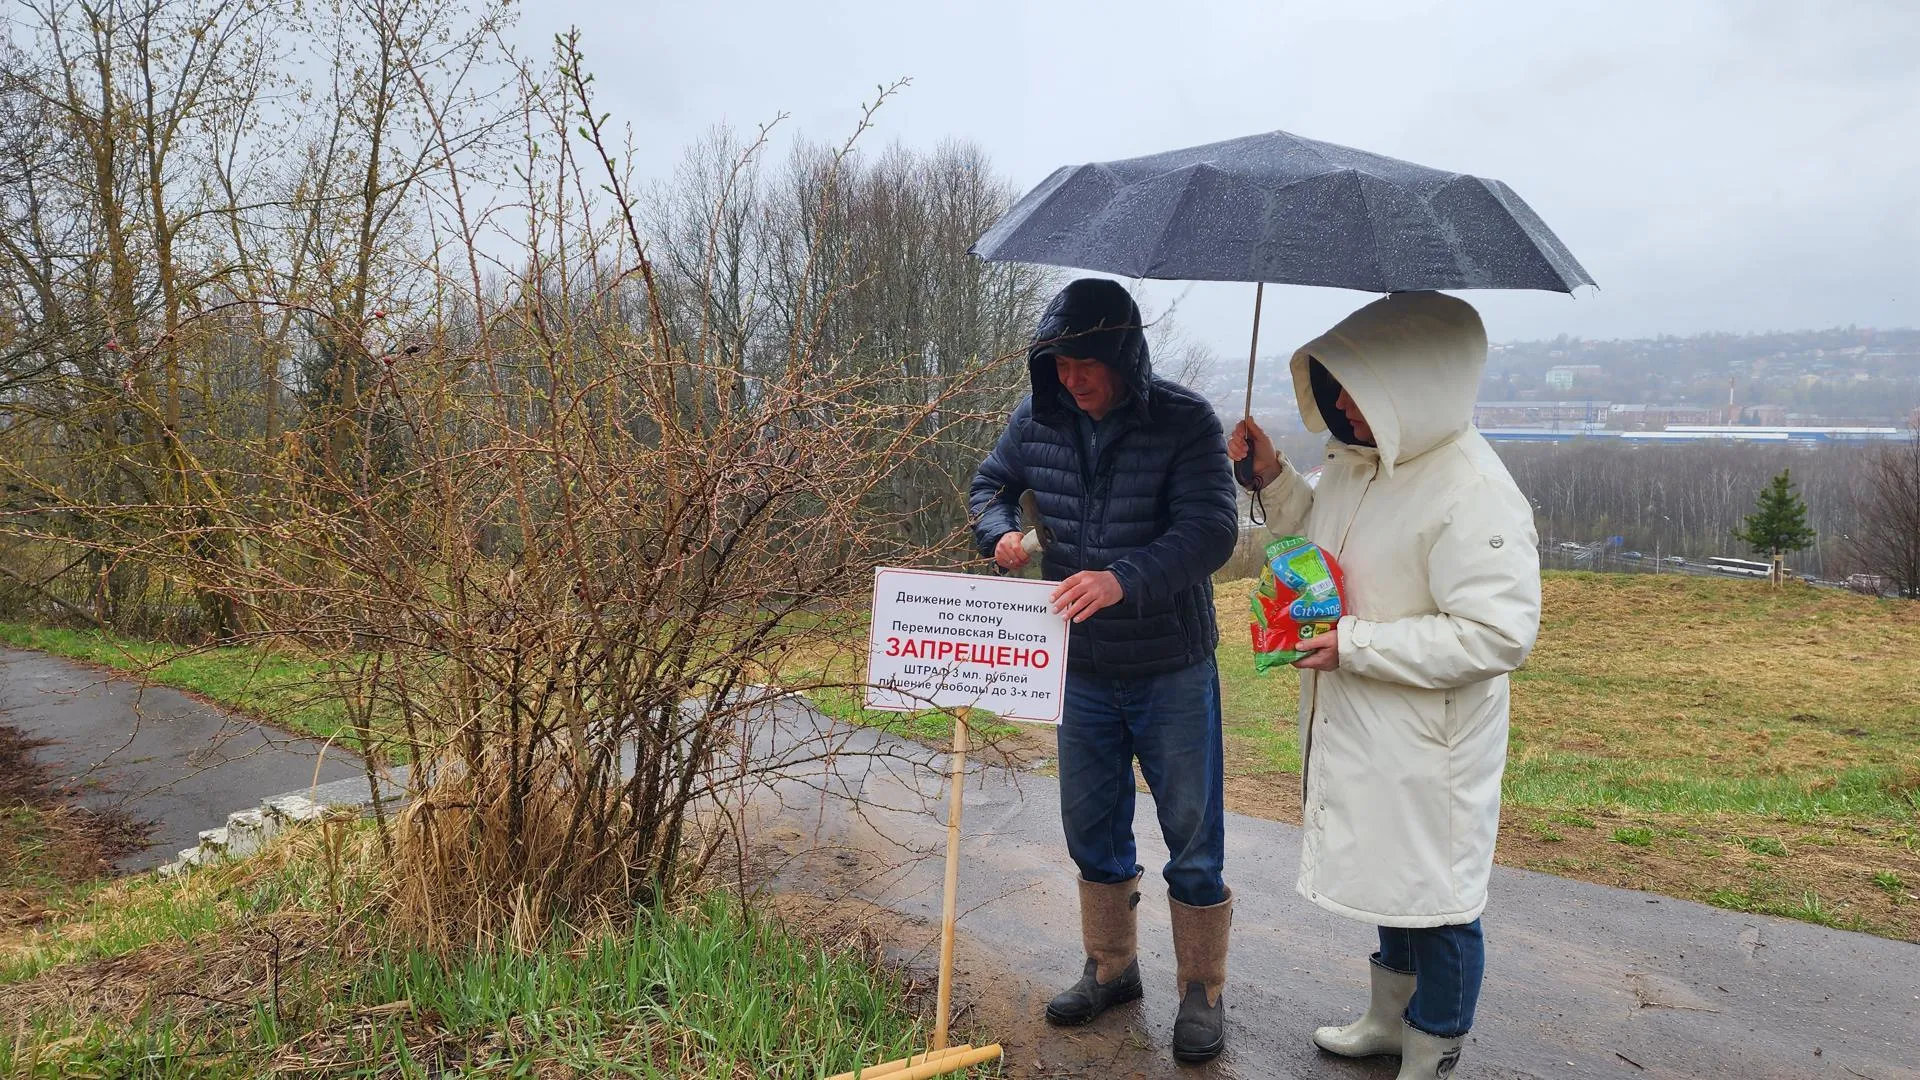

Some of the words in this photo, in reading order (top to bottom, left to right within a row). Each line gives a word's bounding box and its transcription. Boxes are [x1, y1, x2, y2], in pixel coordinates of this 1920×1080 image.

[895, 591, 962, 607] Движение
[965, 599, 1047, 614] мототехники
[938, 611, 955, 621] по
[958, 613, 1003, 627] склону
[892, 620, 994, 639] Перемиловская
[998, 629, 1047, 643] Высота
[885, 637, 1050, 669] ЗАПРЕЩЕНО
[904, 664, 949, 678] ШТРАФ
[952, 668, 959, 678] 3
[962, 671, 982, 680] мл.
[985, 671, 1028, 684] рублей
[935, 682, 989, 694] свободы
[991, 687, 1007, 697] до
[1010, 689, 1027, 698] 3-х
[1030, 690, 1051, 700] лет
